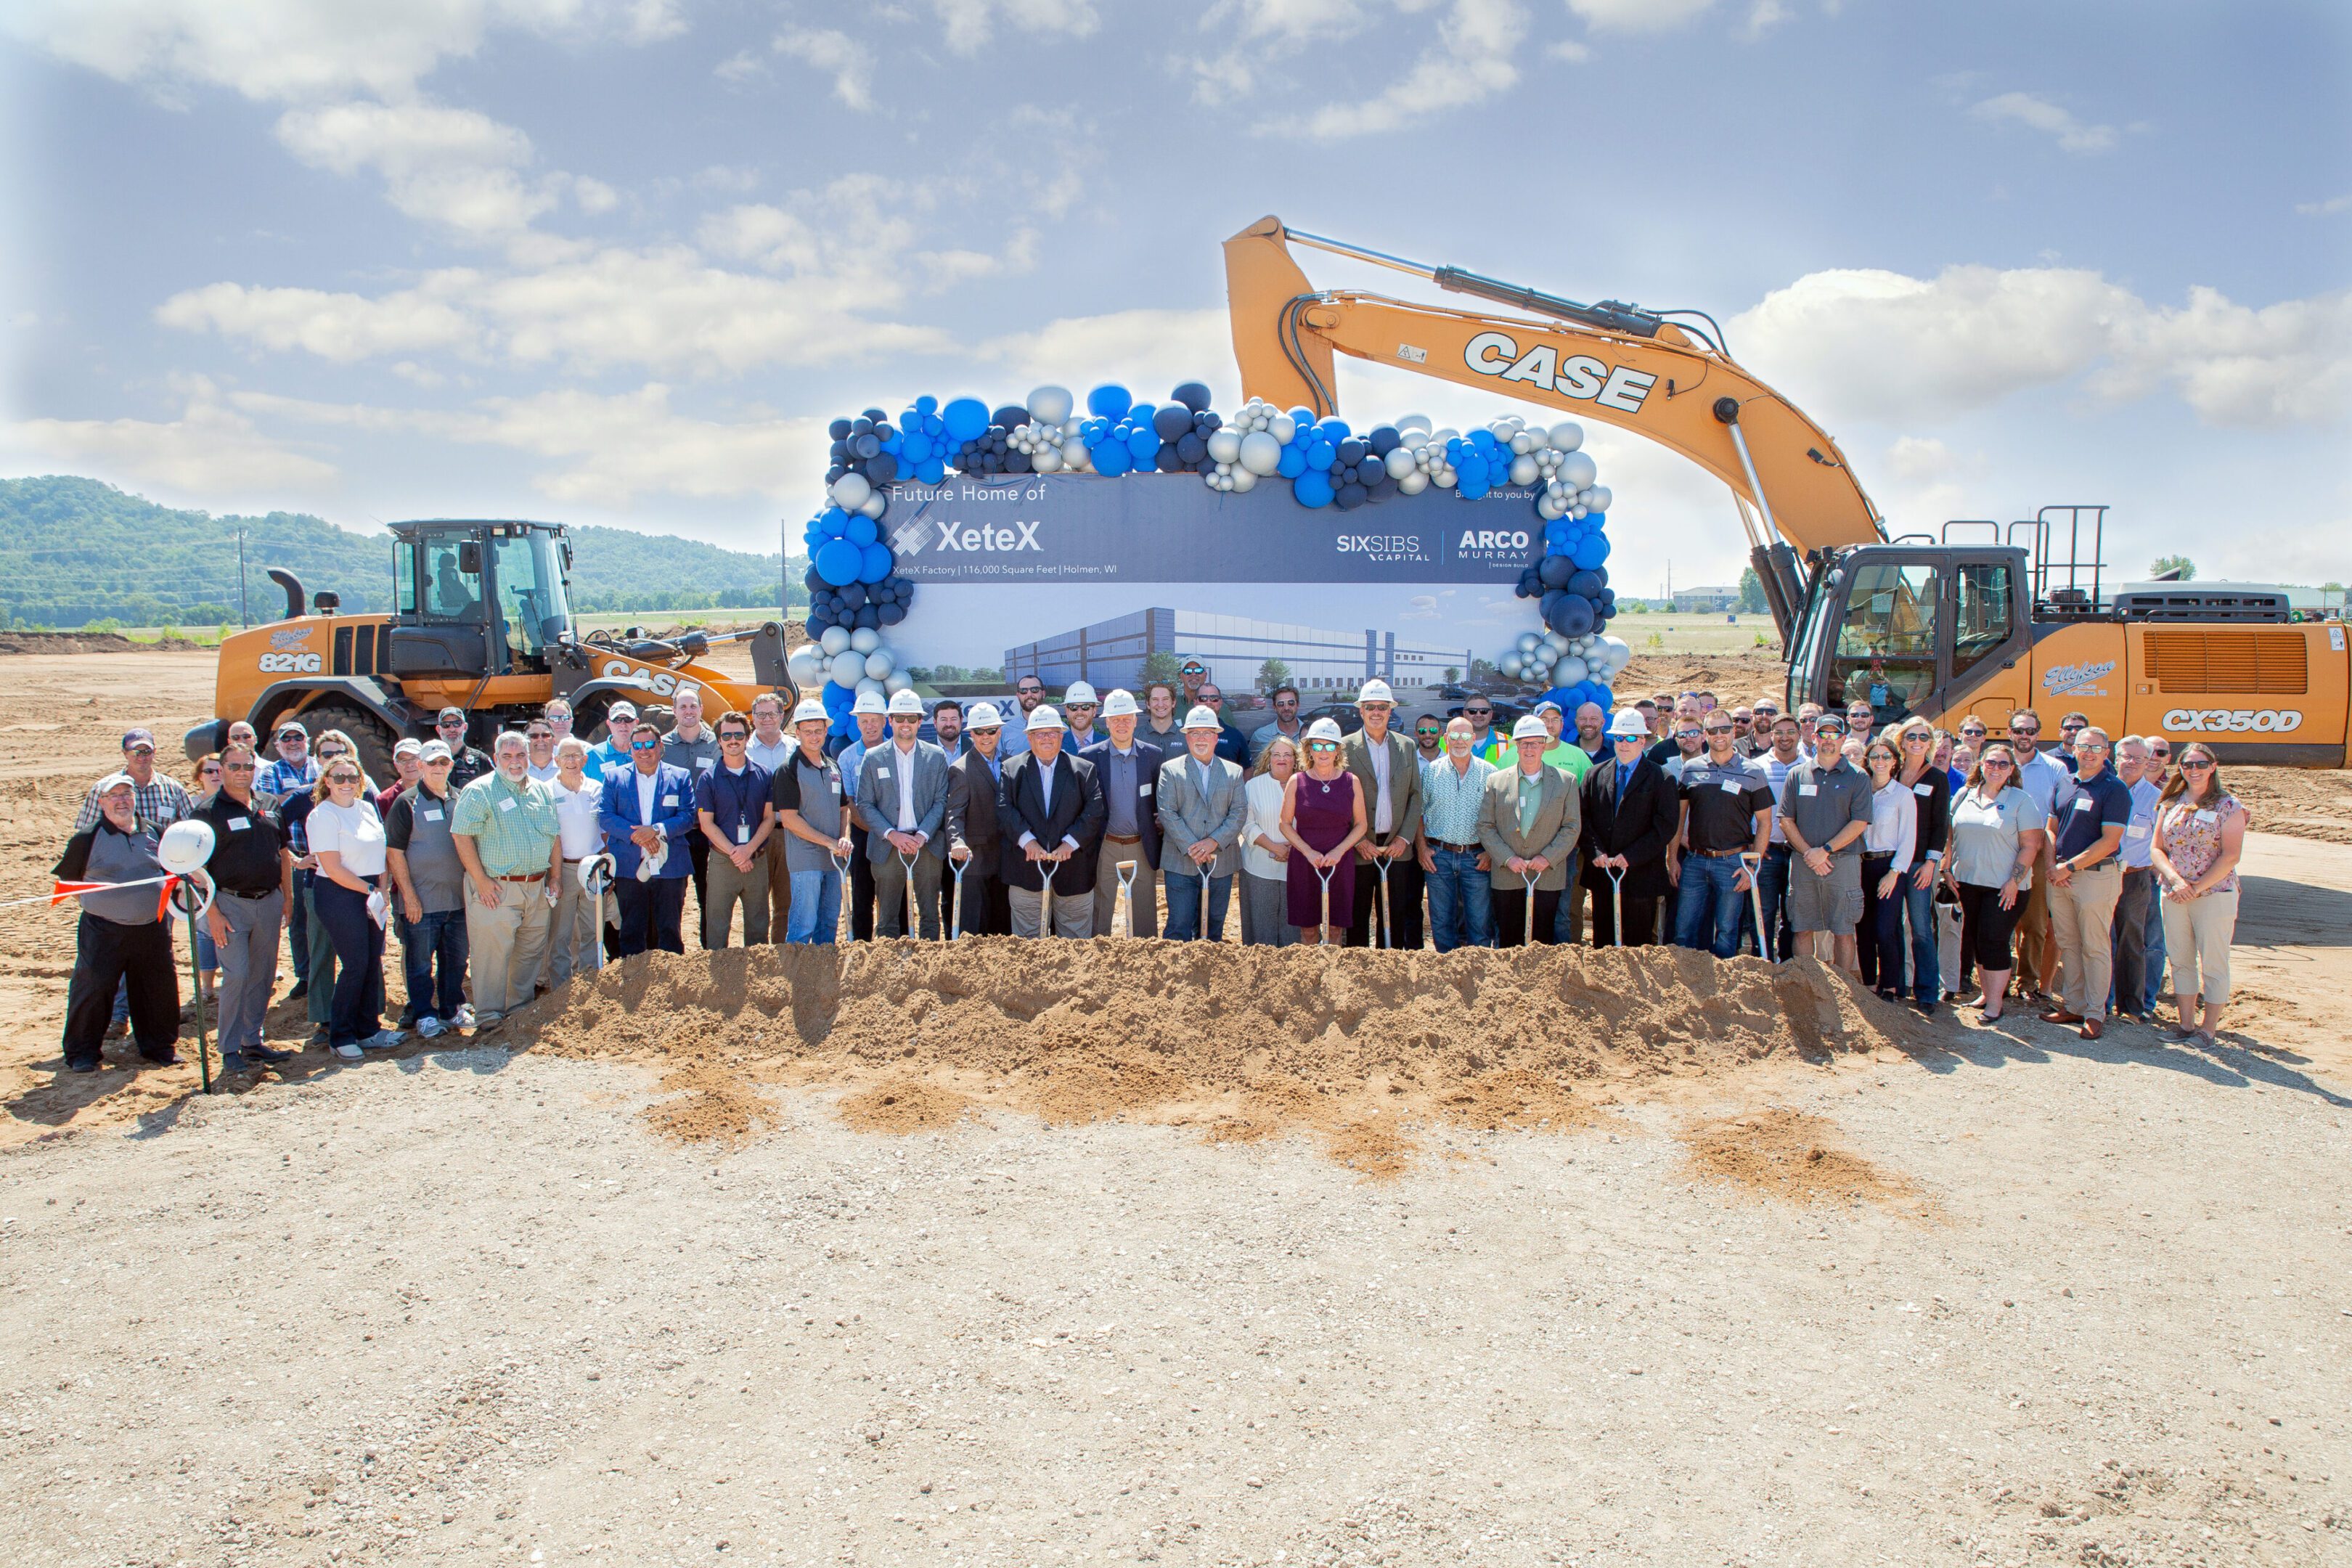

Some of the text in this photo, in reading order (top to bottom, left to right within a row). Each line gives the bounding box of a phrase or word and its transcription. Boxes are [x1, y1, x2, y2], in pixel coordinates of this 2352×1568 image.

[1463, 331, 1658, 414] CASE
[892, 483, 1046, 502] Future Home of
[1505, 492, 1522, 501] you
[1524, 490, 1535, 501] by
[936, 521, 1042, 552] XeteX
[1336, 535, 1419, 552] SIXSIBS
[1459, 530, 1529, 549] ARCO
[893, 564, 1117, 576] XeteX Factory 116,000 Square Feet Holmen, WI
[258, 652, 322, 673] 821G
[2162, 708, 2304, 732] CX350D
